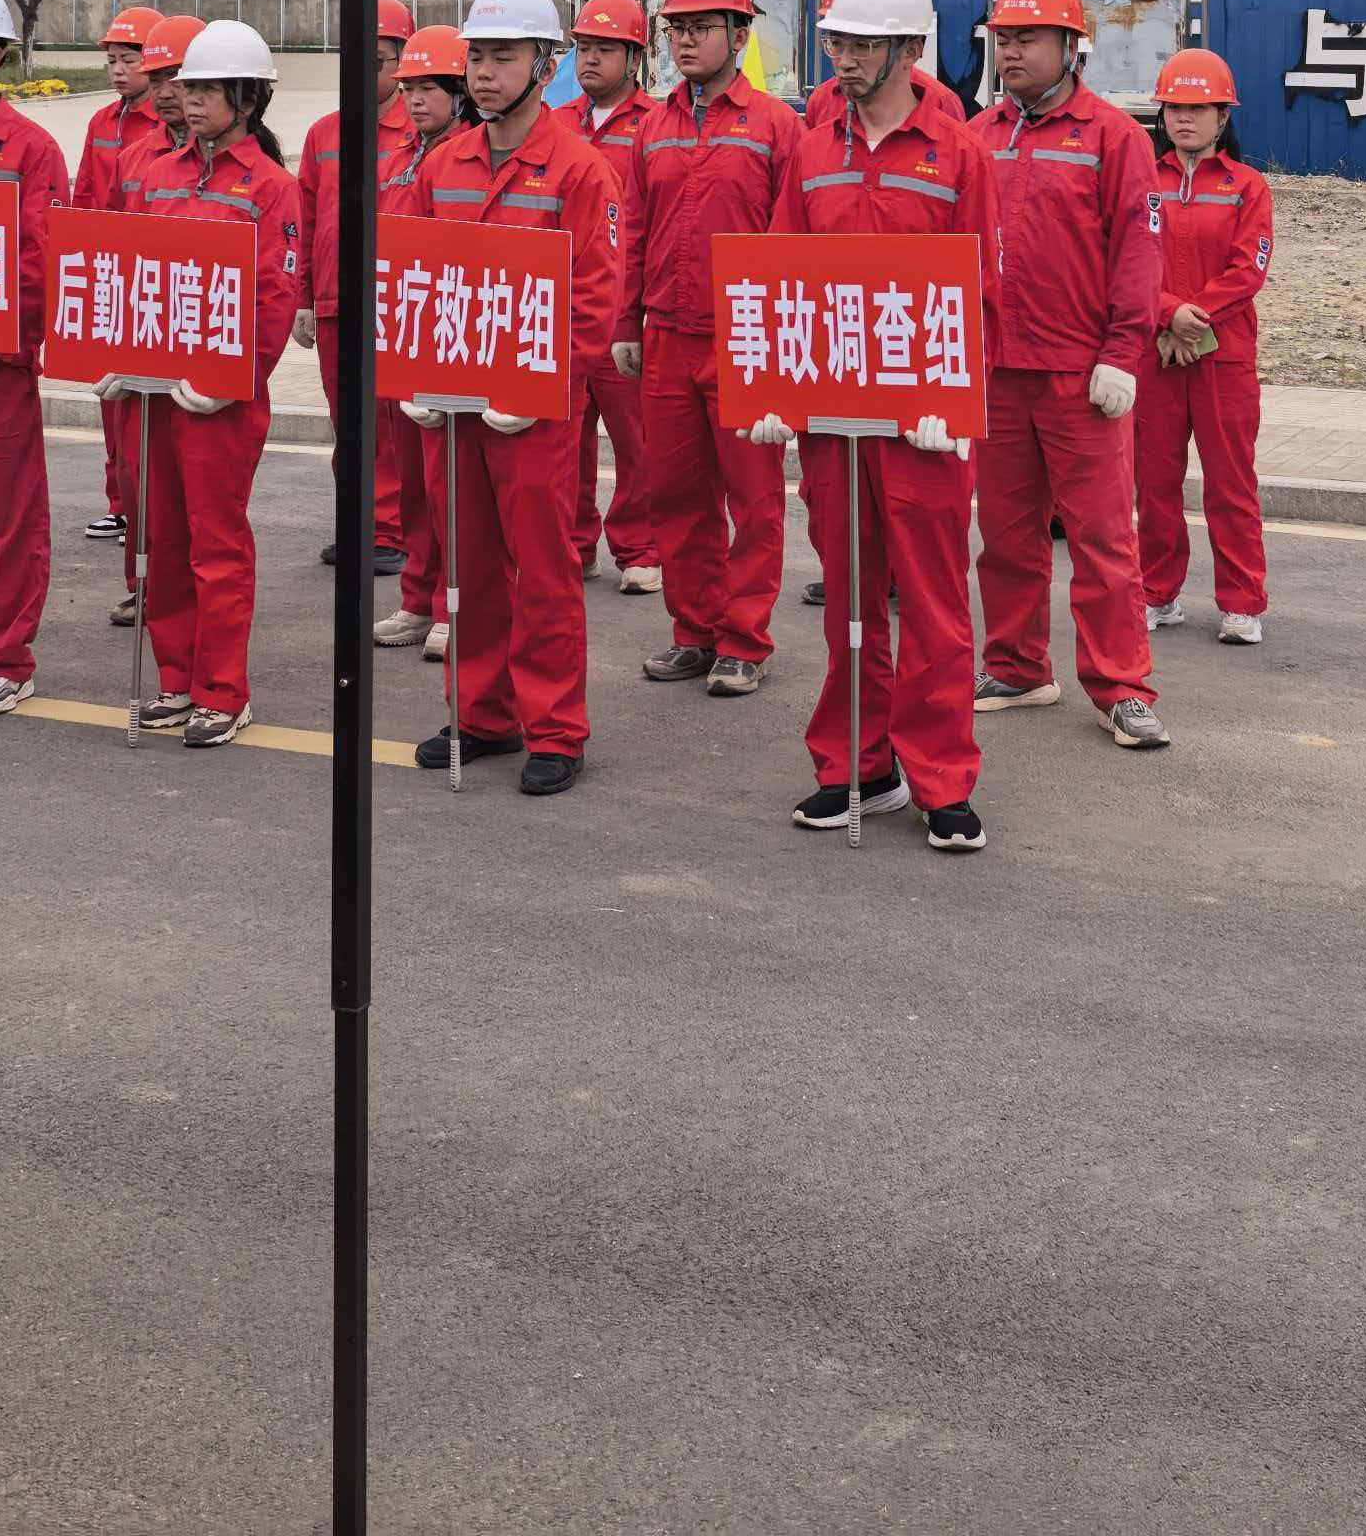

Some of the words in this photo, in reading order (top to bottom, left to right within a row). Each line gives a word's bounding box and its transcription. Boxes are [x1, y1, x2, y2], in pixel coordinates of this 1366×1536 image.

[54, 250, 243, 357] 后勤保障组
[725, 278, 971, 388] 事故调查组
